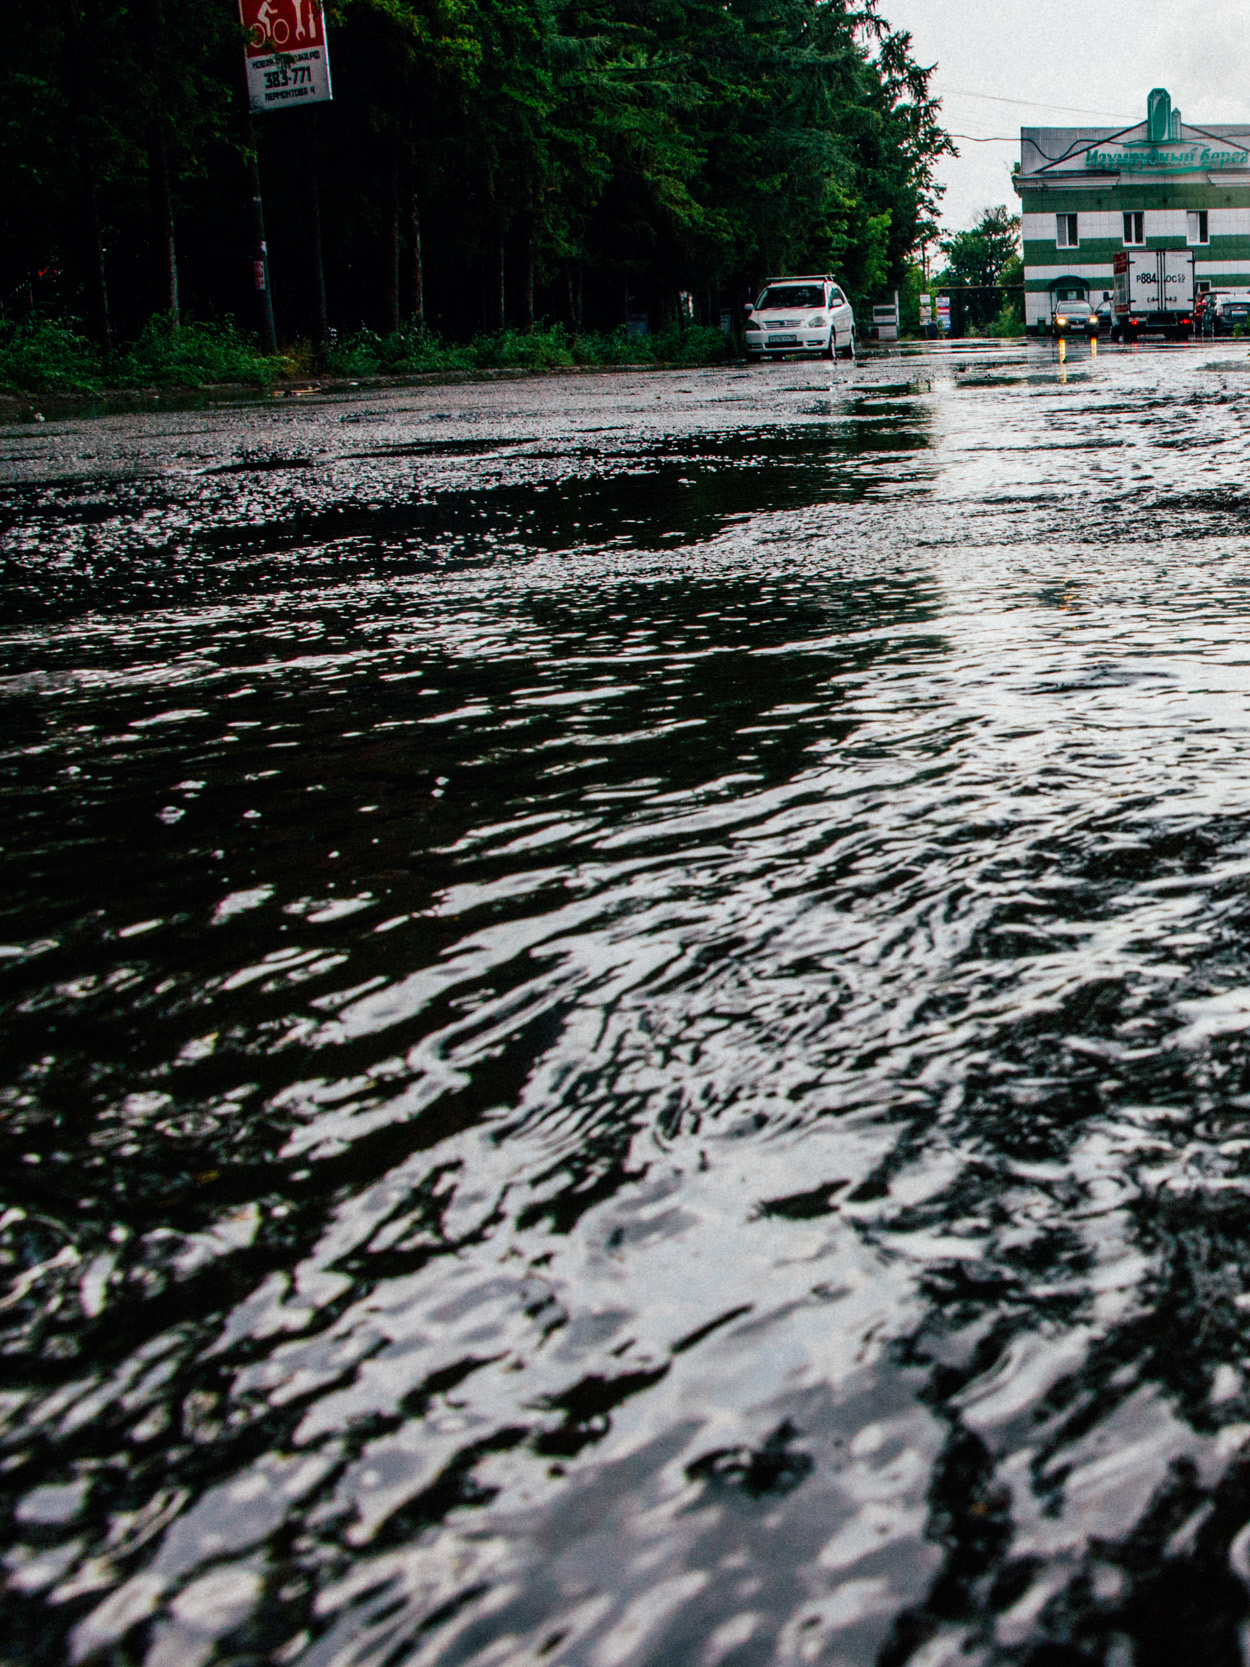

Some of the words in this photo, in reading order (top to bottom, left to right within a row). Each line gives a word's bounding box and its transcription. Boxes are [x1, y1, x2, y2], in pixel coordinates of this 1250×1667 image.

[264, 65, 311, 88] 383-771
[1085, 147, 1198, 169] Изумрудный
[1200, 148, 1249, 167] берег
